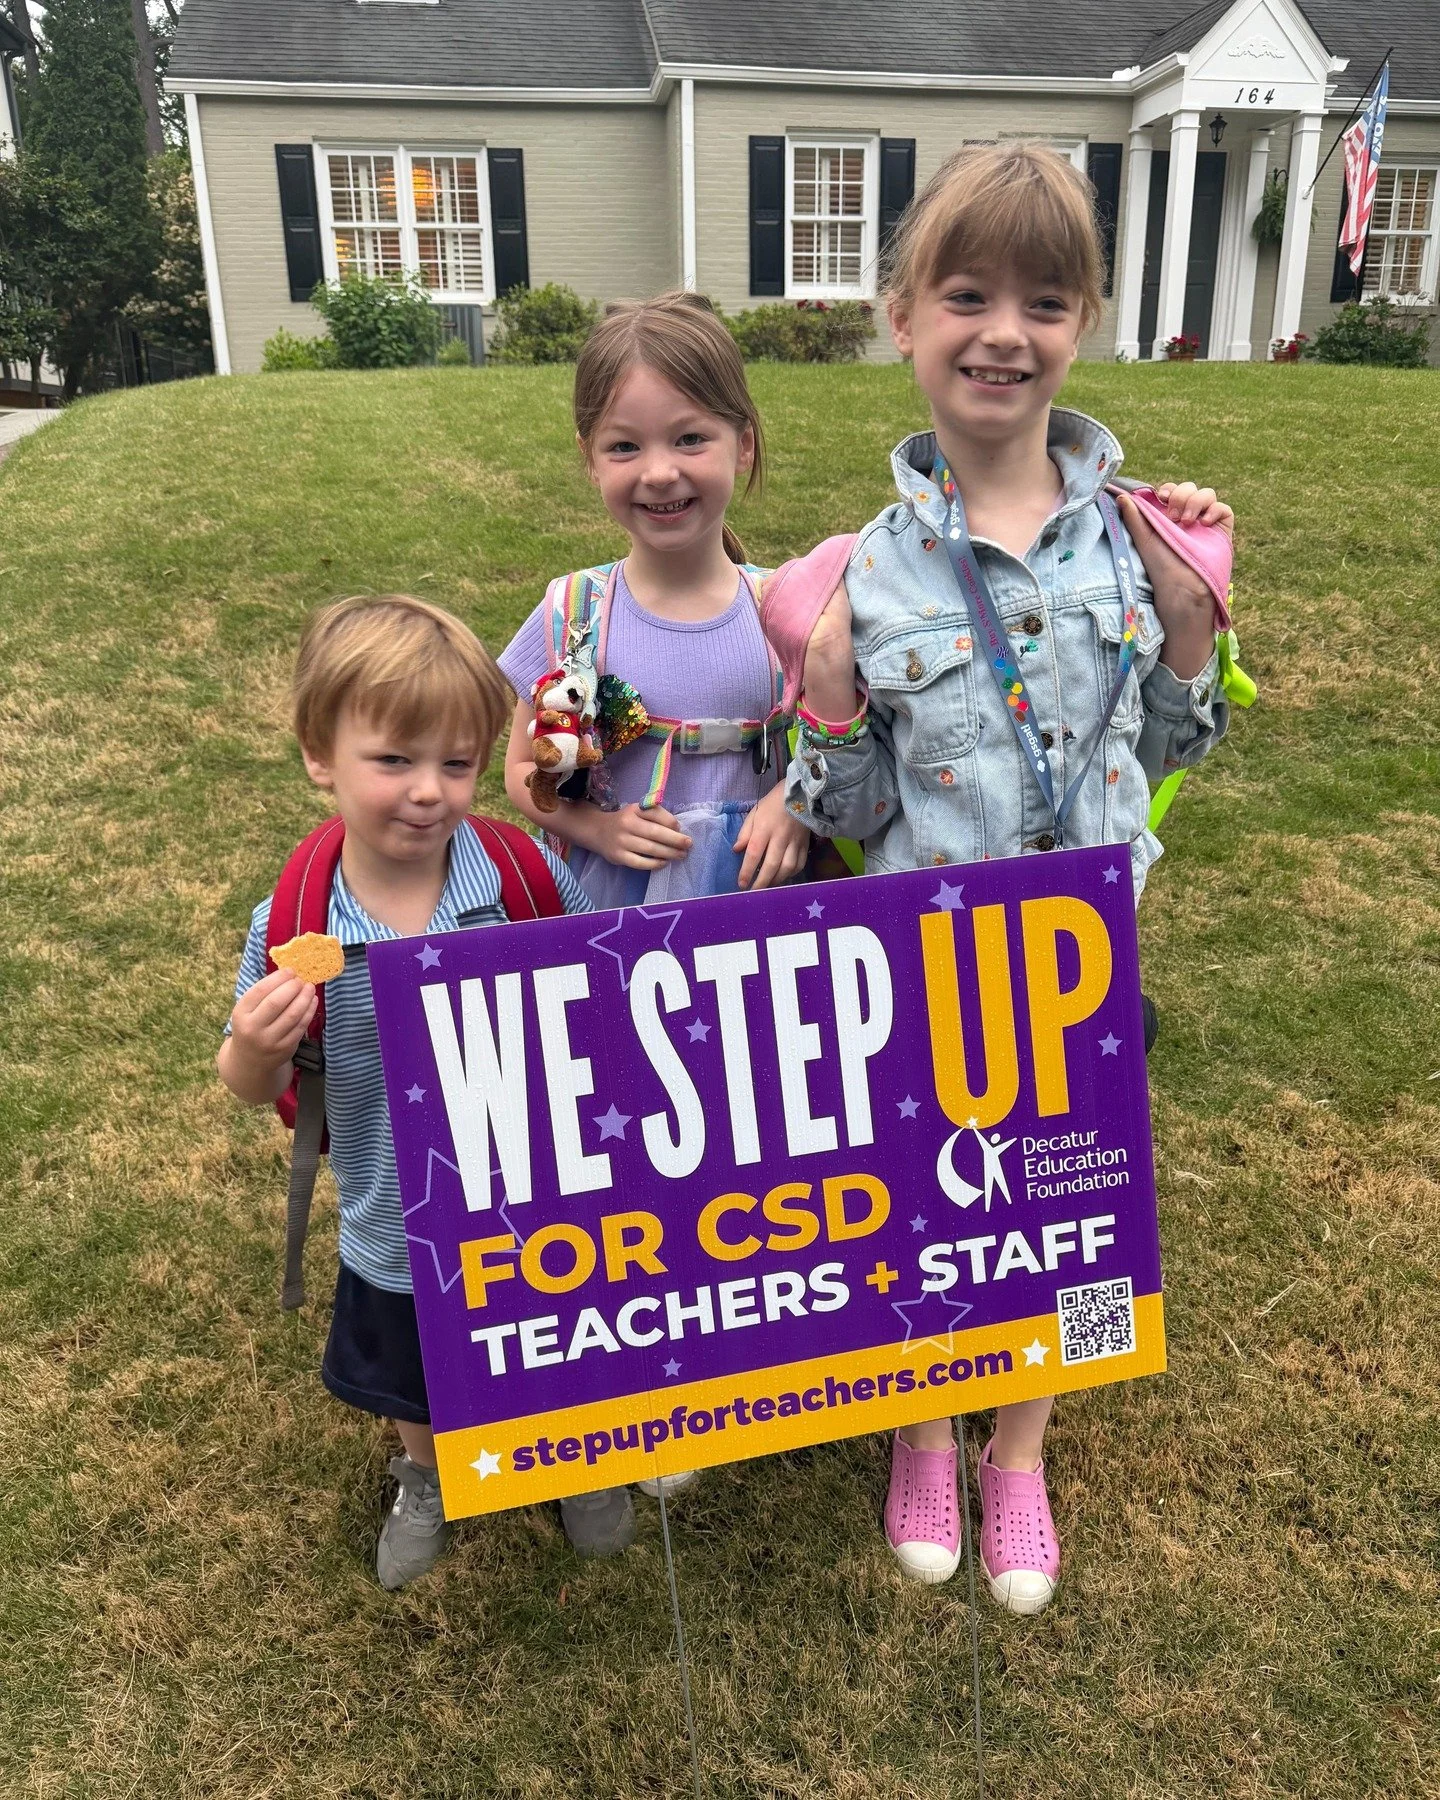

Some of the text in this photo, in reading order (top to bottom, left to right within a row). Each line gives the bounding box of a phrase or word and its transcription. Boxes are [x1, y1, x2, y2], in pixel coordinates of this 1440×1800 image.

[1235, 87, 1275, 104] 164
[1020, 723, 1043, 758] gsgatl
[420, 896, 1113, 1212] WE STEP UP
[1022, 1130, 1098, 1156] Decatur
[1024, 1147, 1127, 1178] Education
[1026, 1170, 1130, 1201] Foundation
[459, 1173, 892, 1310] FOR CSD
[470, 1214, 1116, 1376] TEACHERS + STAFF
[512, 1349, 1014, 1472] stepupforteachers.com
